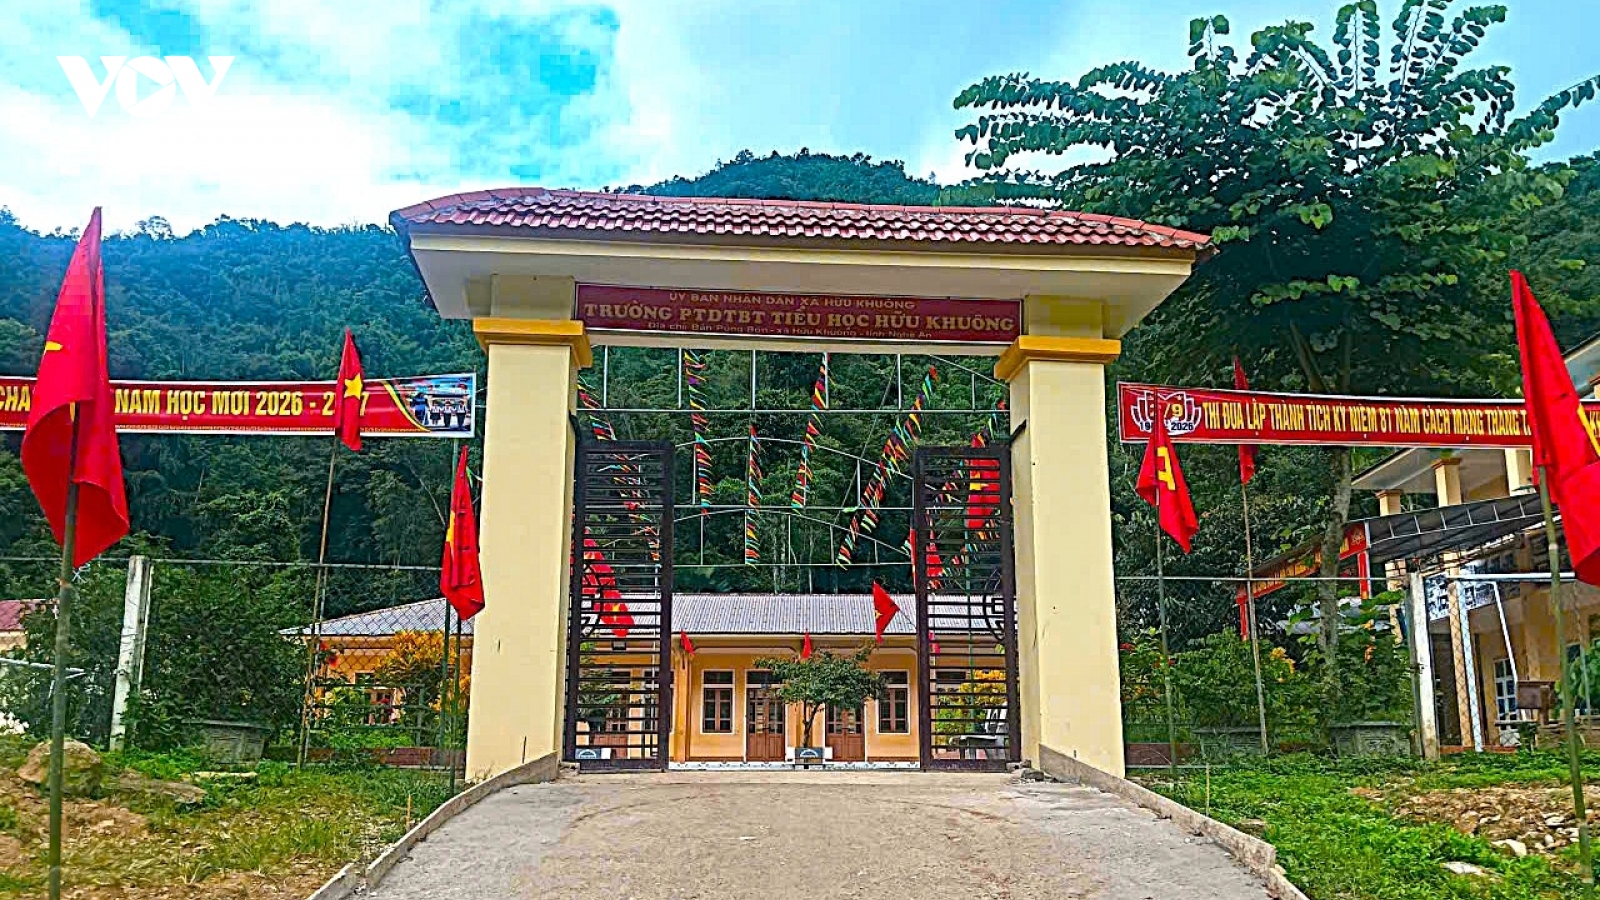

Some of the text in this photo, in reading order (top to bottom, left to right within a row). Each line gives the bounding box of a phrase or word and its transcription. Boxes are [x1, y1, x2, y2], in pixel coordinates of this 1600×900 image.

[689, 292, 720, 303] BAN
[723, 294, 761, 305] NHÂN
[765, 295, 795, 306] DÂN
[800, 296, 820, 306] XÃ
[584, 300, 1015, 332] TRƯỜNG PTDTBT TIỂU HỌC HỮU KHUÔNG
[166, 390, 206, 420] HỌC
[255, 391, 303, 416] 2026
[321, 391, 370, 416] 27
[1202, 402, 1221, 430] THI
[1222, 402, 1245, 430] ĐUA
[1245, 398, 1266, 436] LẬP
[1268, 399, 1305, 431] THÀNH
[1306, 400, 1331, 432] TÍCH
[1348, 403, 1378, 439] NIỆM
[1379, 407, 1392, 433] 81
[1421, 404, 1450, 435] CÁCH
[1451, 408, 1485, 441] MẠNG
[1485, 405, 1521, 436] THÁNG
[1170, 421, 1194, 431] 2026
